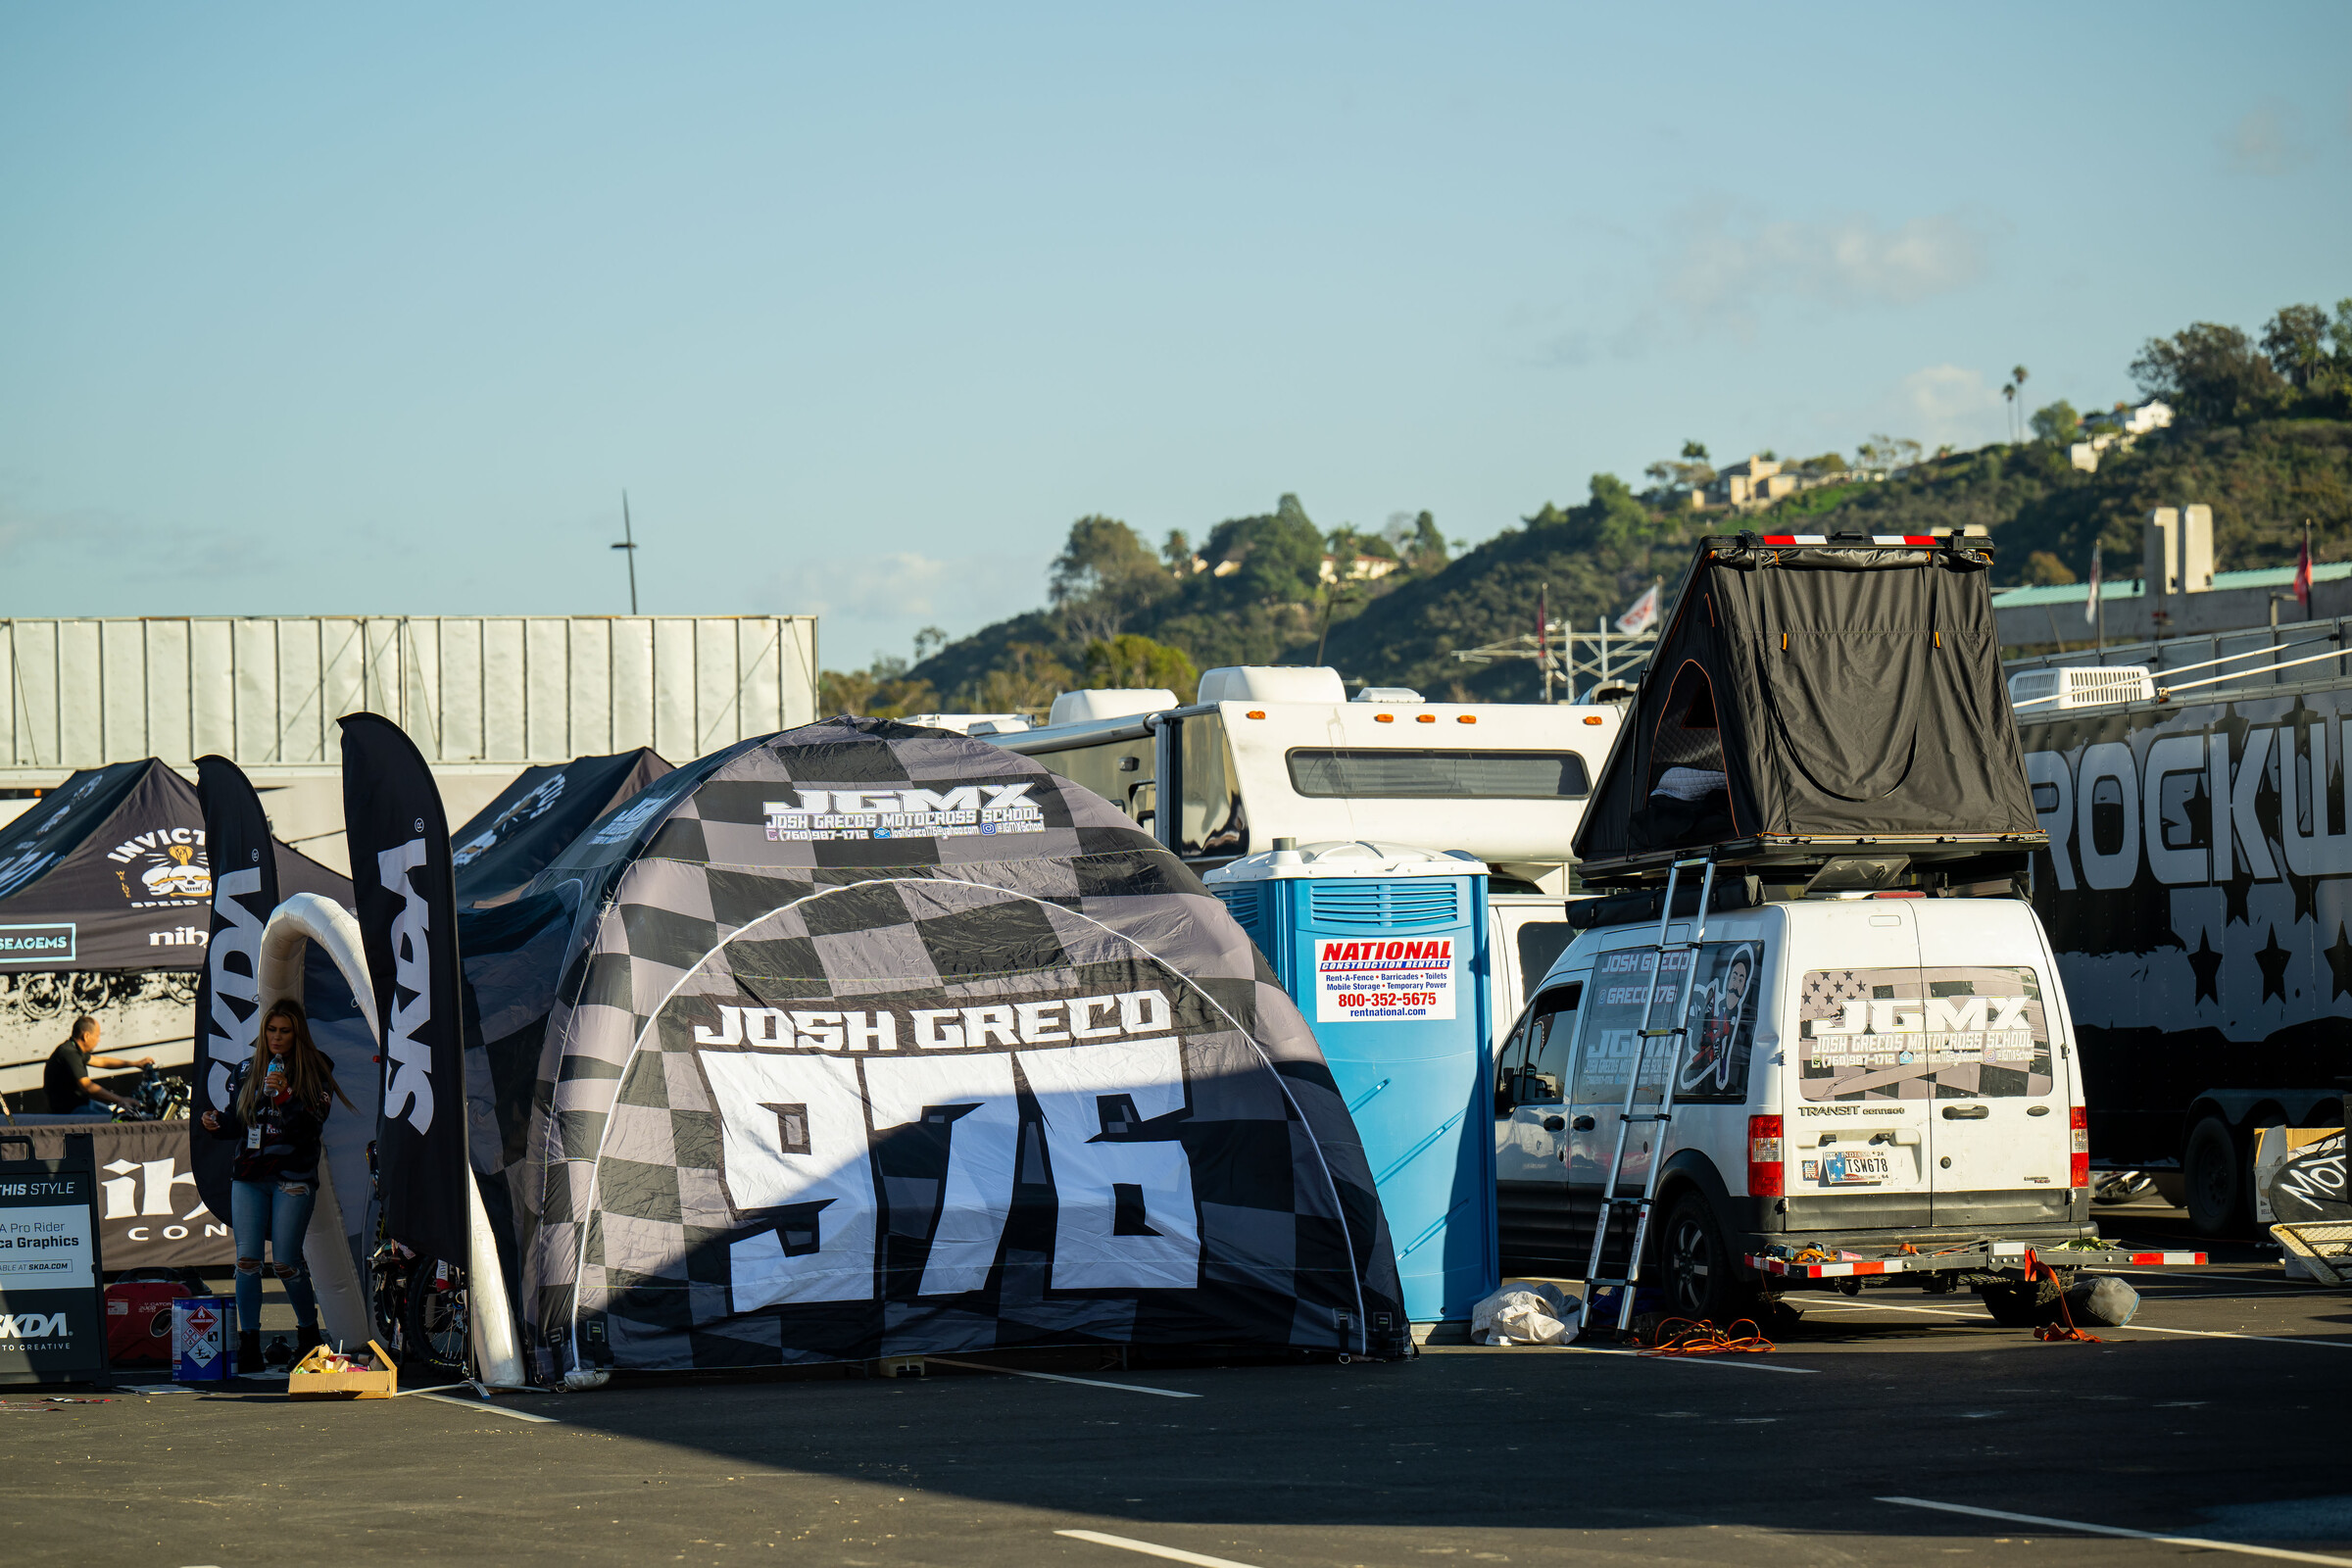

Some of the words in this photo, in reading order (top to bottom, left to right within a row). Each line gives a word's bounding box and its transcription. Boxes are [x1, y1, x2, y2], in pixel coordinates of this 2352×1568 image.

[763, 783, 1042, 815] JGMX
[765, 815, 808, 829] JOSH
[882, 810, 977, 828] MOTOCROSS
[982, 808, 1045, 822] SCHOOL
[1322, 941, 1451, 961] NATIONAL
[1321, 961, 1403, 970] CONSTRUCTION
[1601, 953, 1640, 973] JOSH
[377, 838, 434, 1136] SKDA
[1352, 982, 1381, 991] Storage
[1387, 981, 1424, 991] Temporary
[1338, 992, 1437, 1007] 800-352-5675
[694, 1004, 898, 1051] JOSH
[909, 990, 1172, 1050] GRECO
[1350, 1007, 1426, 1017] rentnational.com
[1810, 996, 2034, 1036] JGMX
[1812, 1036, 1848, 1054] JOSH
[1907, 1032, 1983, 1052] MOTOCROSS
[1985, 1031, 2034, 1048] SCHOOL
[1798, 1105, 1860, 1116] TRANSIT
[1862, 1106, 1905, 1115] connect
[1845, 1158, 1888, 1173] TSW678
[698, 1037, 1201, 1313] 976
[0, 1183, 27, 1196] HIS
[30, 1181, 75, 1196] STYLE
[10, 1223, 30, 1234] Pro
[34, 1221, 65, 1232] Rider
[127, 1223, 227, 1242] CON
[17, 1235, 79, 1250] Graphics
[20, 1343, 71, 1351] CREATIVE
